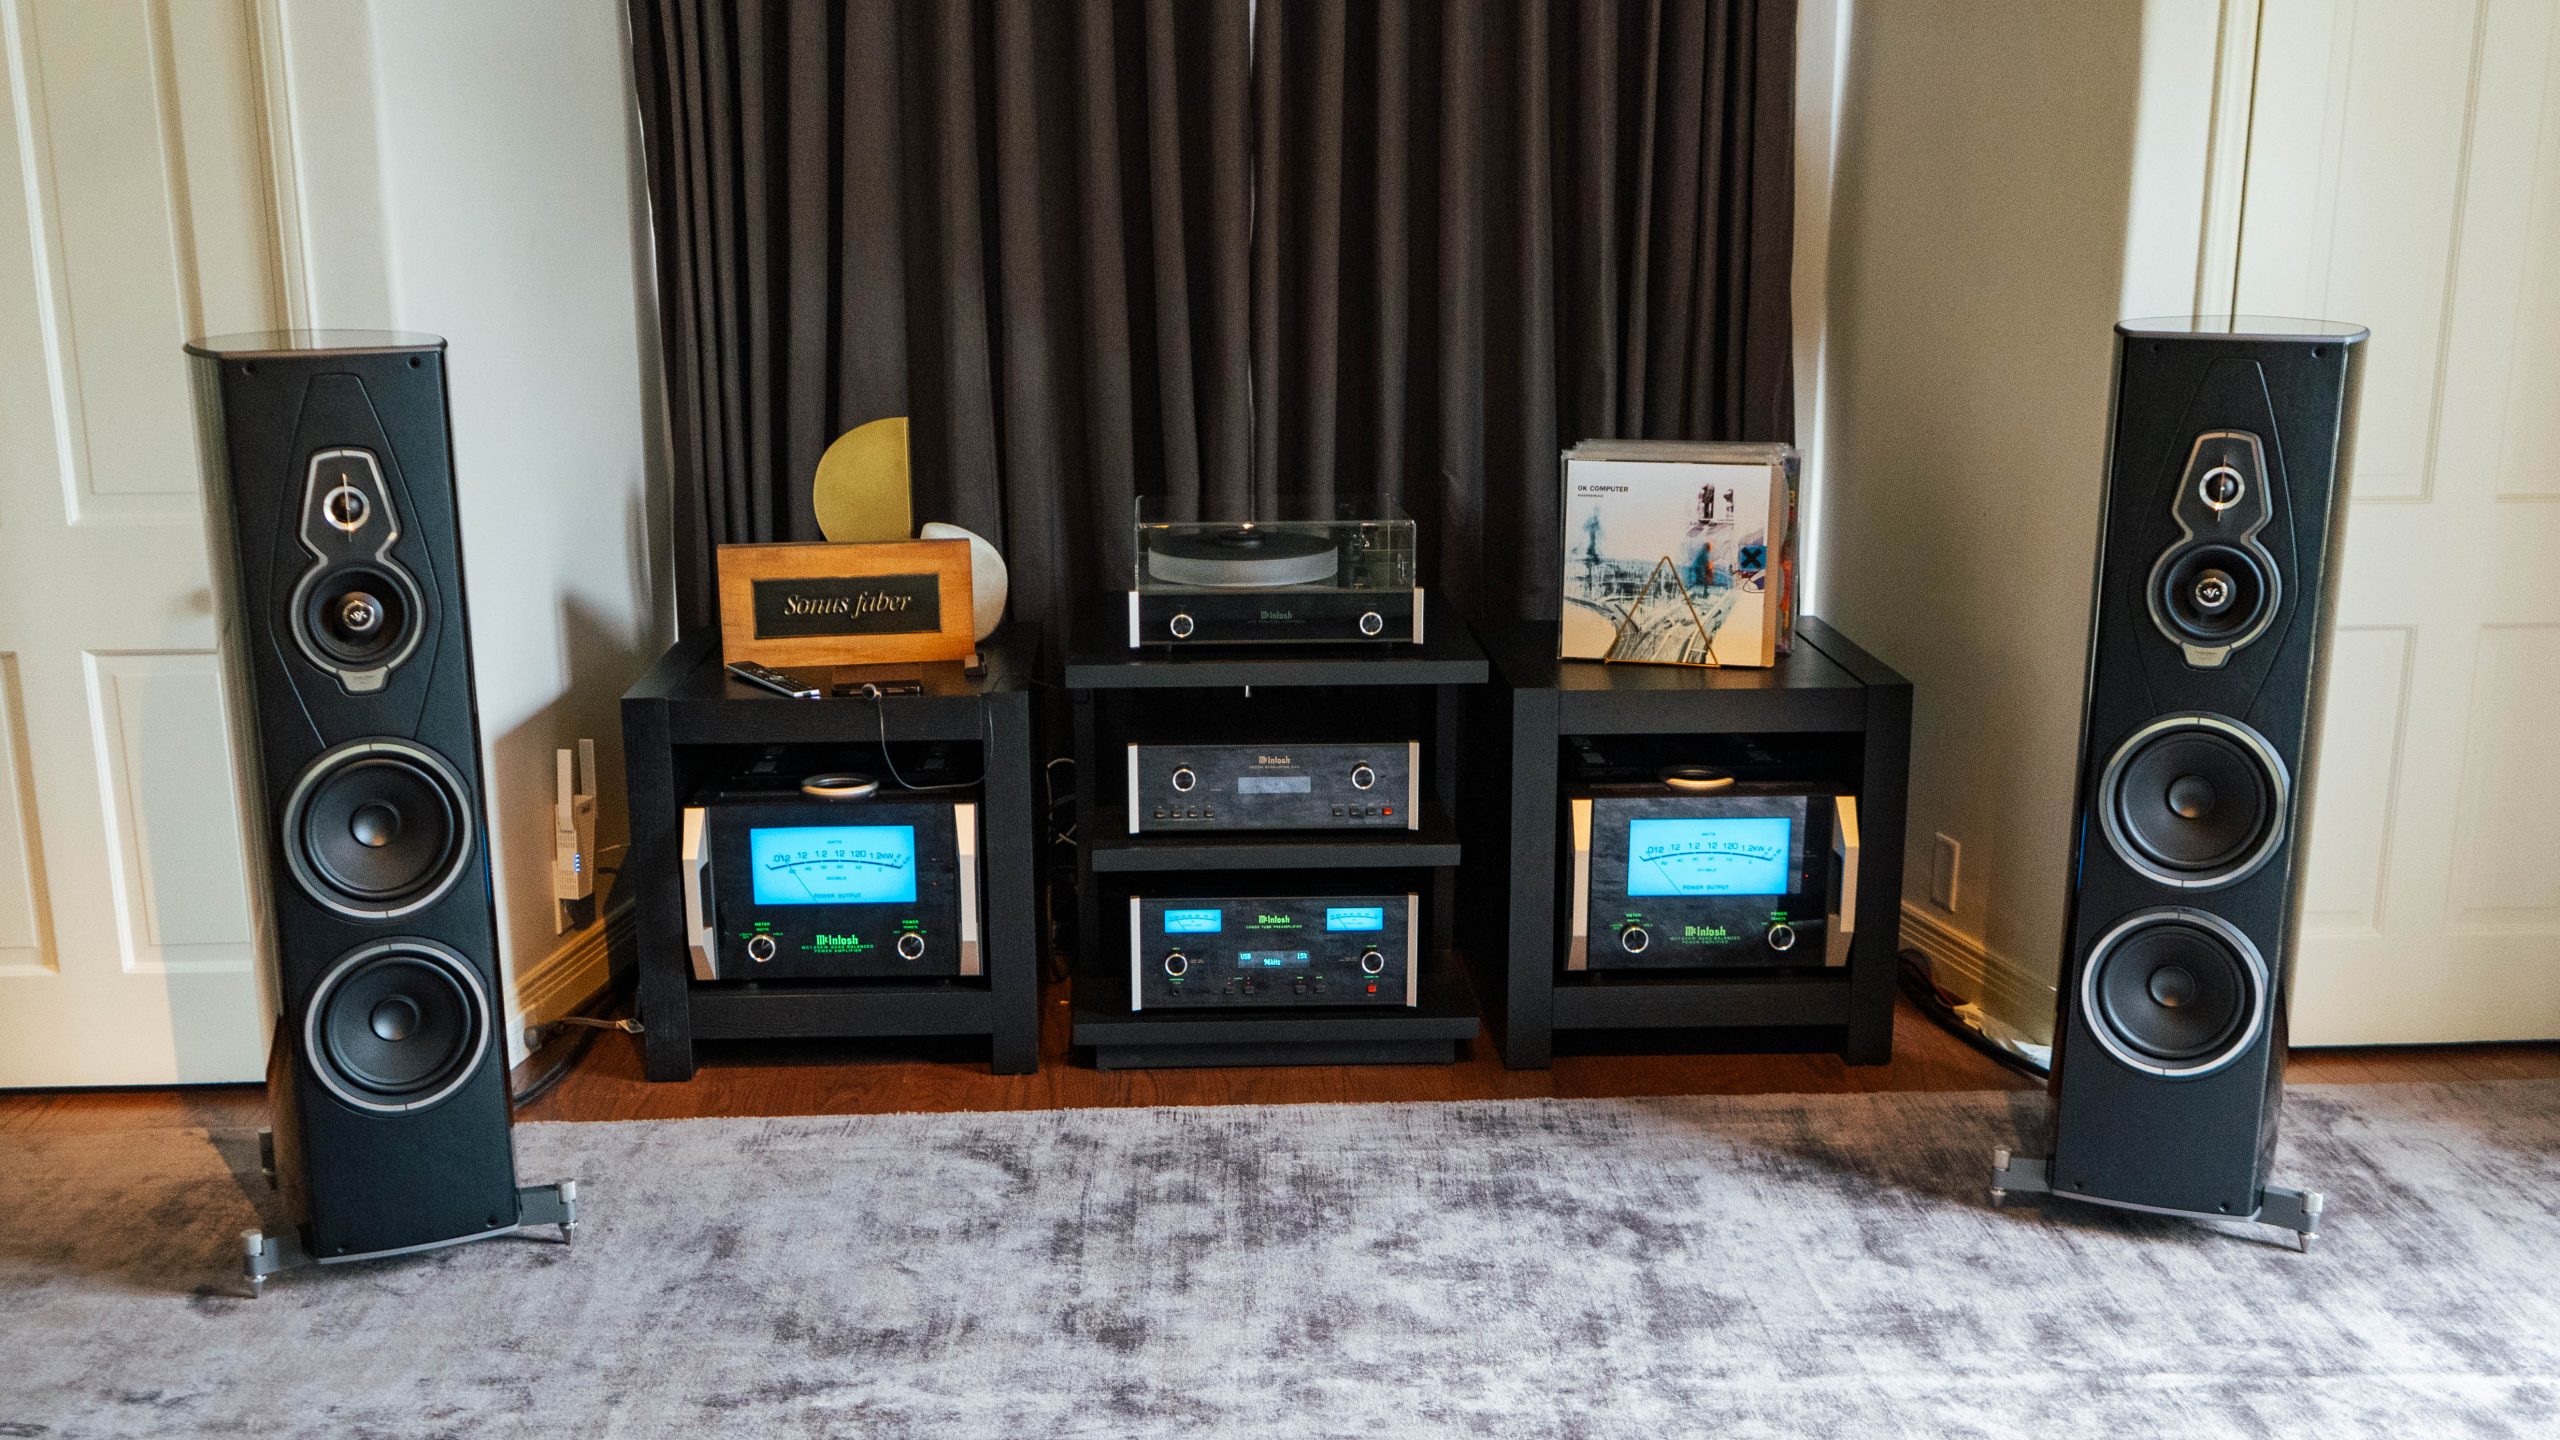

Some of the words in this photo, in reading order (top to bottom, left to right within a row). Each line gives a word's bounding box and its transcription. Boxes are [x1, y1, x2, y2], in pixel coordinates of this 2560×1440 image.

[1589, 485, 1630, 493] COMPUTER
[784, 593, 849, 616] Sonus
[851, 589, 912, 620] faber
[1260, 610, 1293, 619] McIntosh
[1258, 755, 1291, 764] McIntosh
[1708, 842, 1718, 850] 12
[815, 850, 828, 858] 1.2
[835, 849, 845, 858] 12
[850, 850, 867, 859] 120
[1258, 915, 1290, 924] McIntosh
[1685, 926, 1726, 936] McIntosh
[815, 934, 859, 945] McIntosh
[1240, 952, 1252, 960] USB
